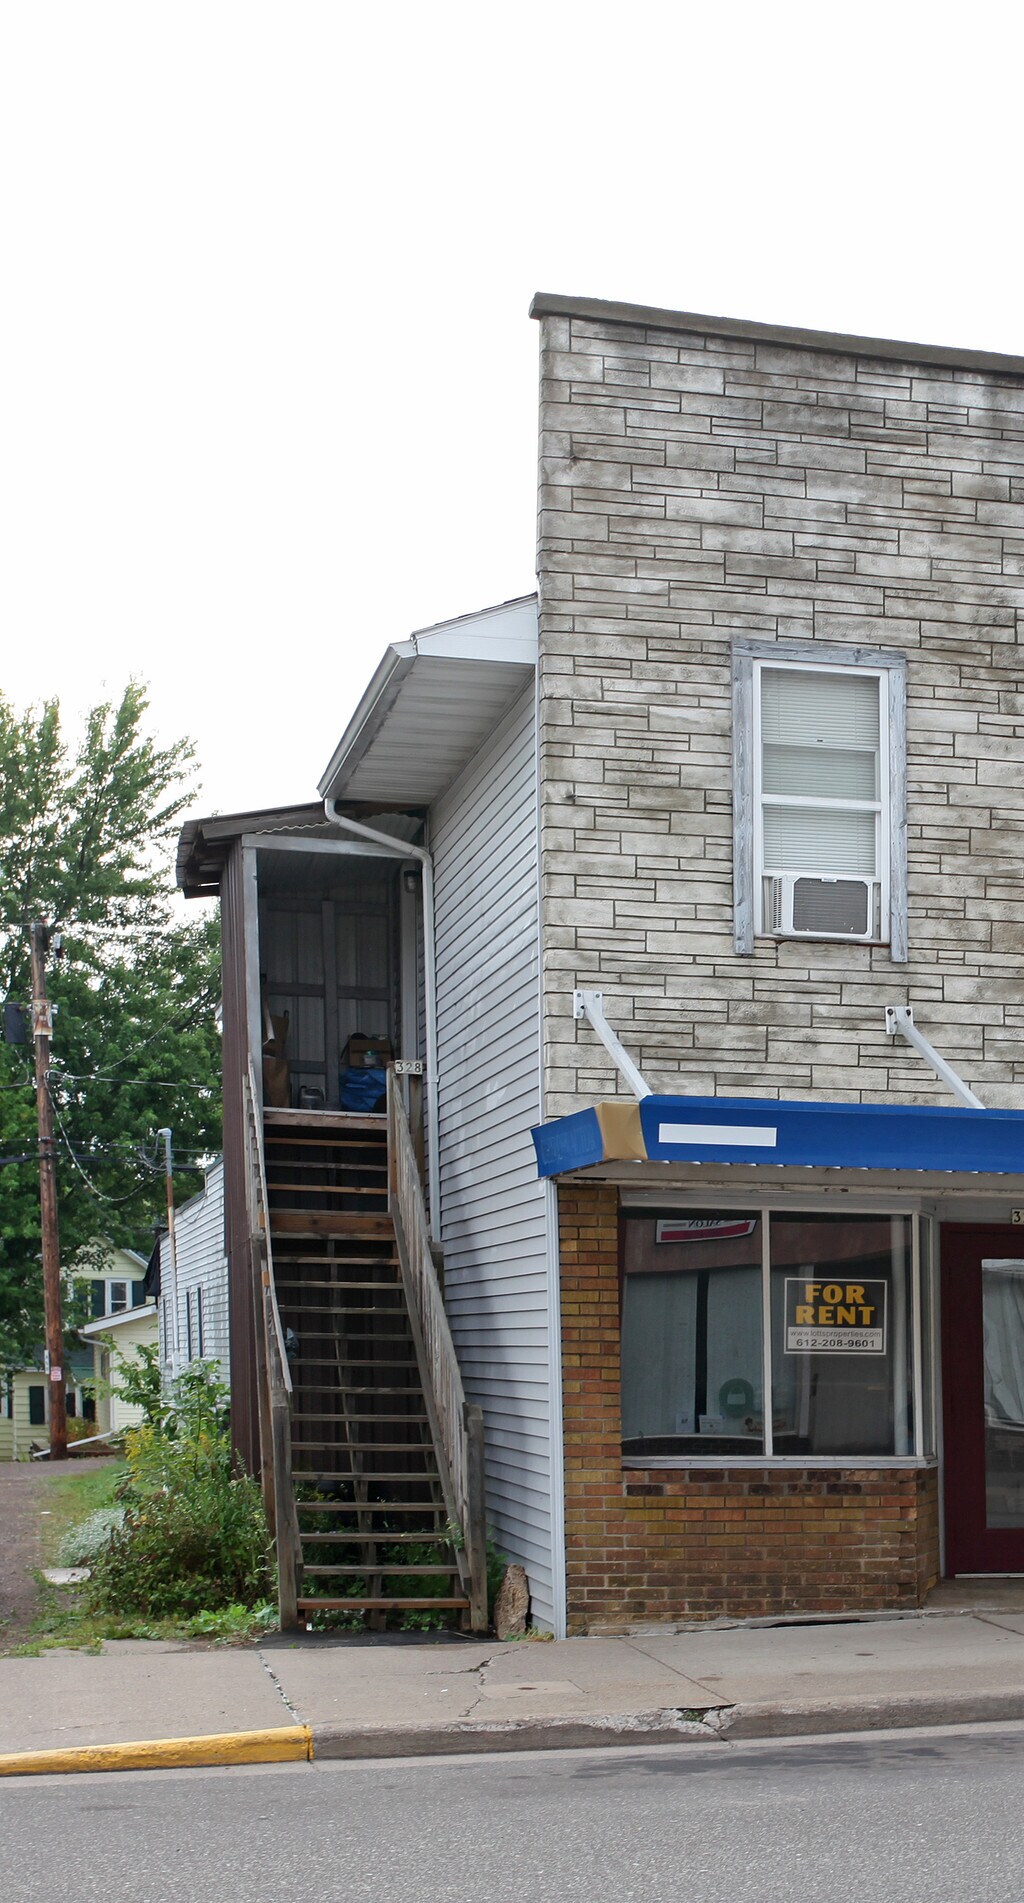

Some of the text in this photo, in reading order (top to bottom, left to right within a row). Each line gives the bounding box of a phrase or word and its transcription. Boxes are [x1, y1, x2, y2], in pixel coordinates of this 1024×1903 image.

[396, 1061, 421, 1073] 328
[805, 1284, 865, 1304] FOR
[795, 1305, 875, 1325] RENT
[796, 1339, 875, 1348] 612-208-9601
